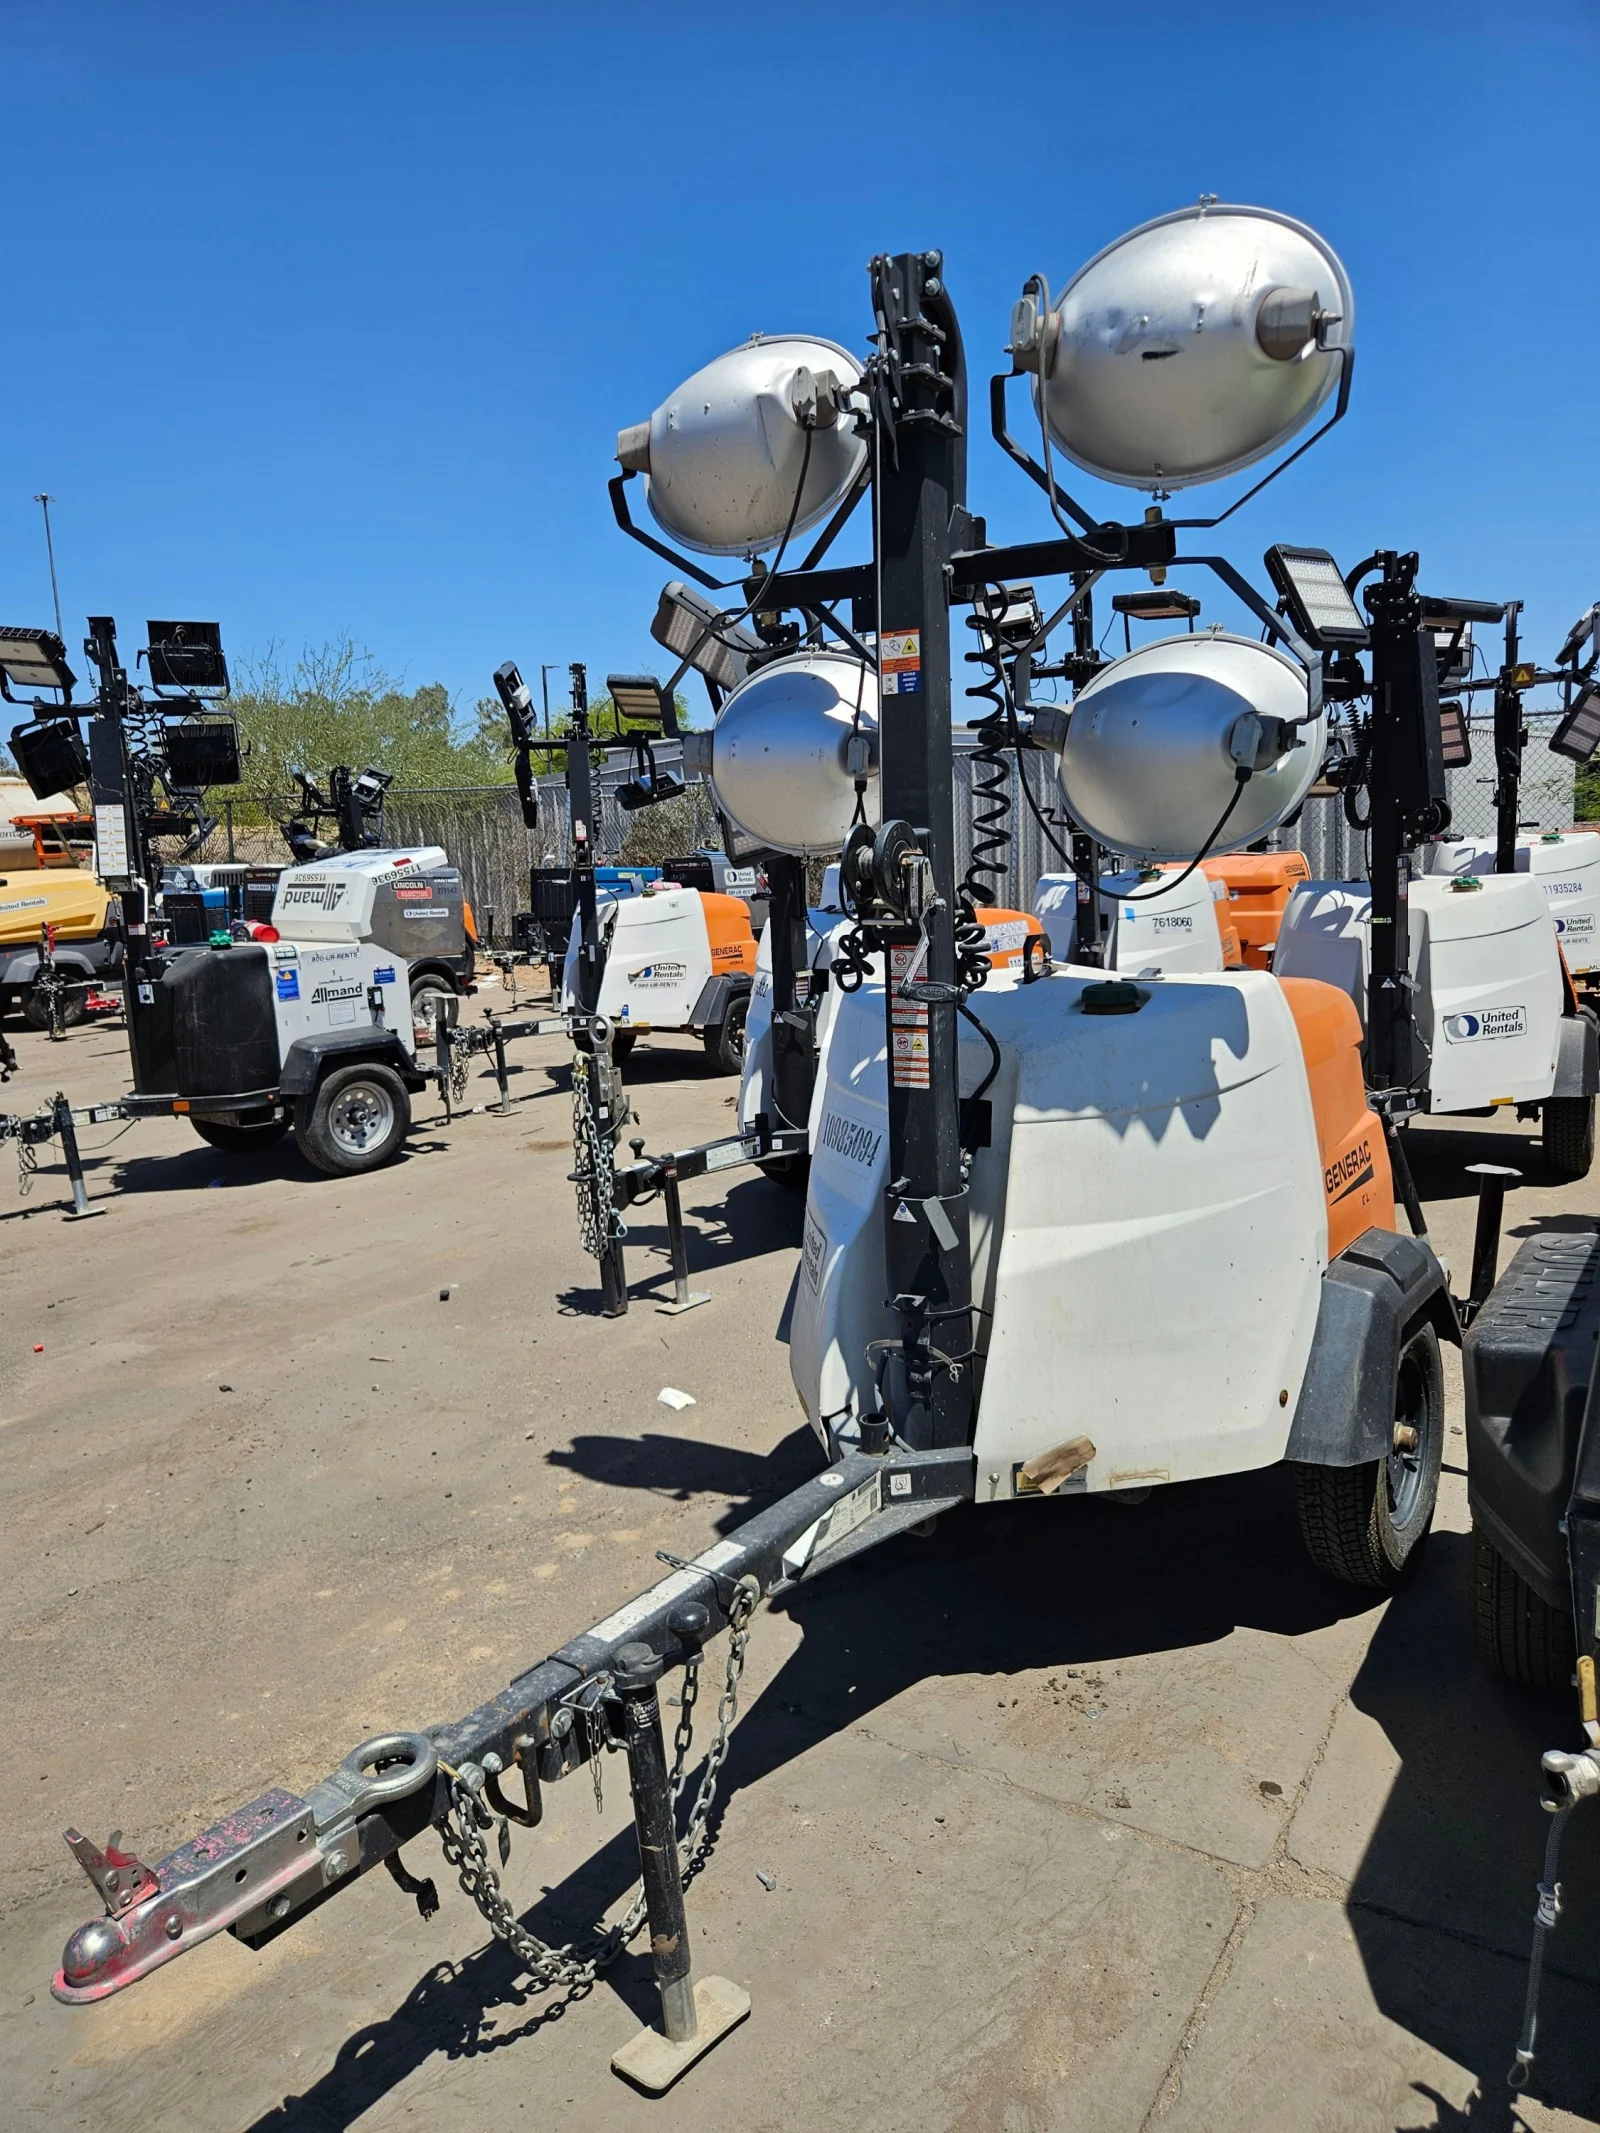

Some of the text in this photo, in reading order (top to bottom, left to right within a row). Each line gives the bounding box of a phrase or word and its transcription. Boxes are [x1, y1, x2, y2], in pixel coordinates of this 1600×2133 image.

[393, 881, 424, 889] LINCOLN
[1543, 882, 1582, 895] 11935284
[21, 898, 46, 908] Rentals
[282, 883, 346, 911] Allmand
[1152, 917, 1192, 928] 7618060
[1566, 917, 1591, 926] United
[1567, 924, 1593, 933] Rentals
[711, 945, 743, 956] GENERAC
[653, 970, 684, 979] Rentals
[311, 982, 363, 1004] Allmand
[1481, 1009, 1519, 1024] United
[1482, 1020, 1524, 1036] Rentals
[822, 1112, 883, 1168] 10985094
[1324, 1139, 1372, 1195] GENERAC
